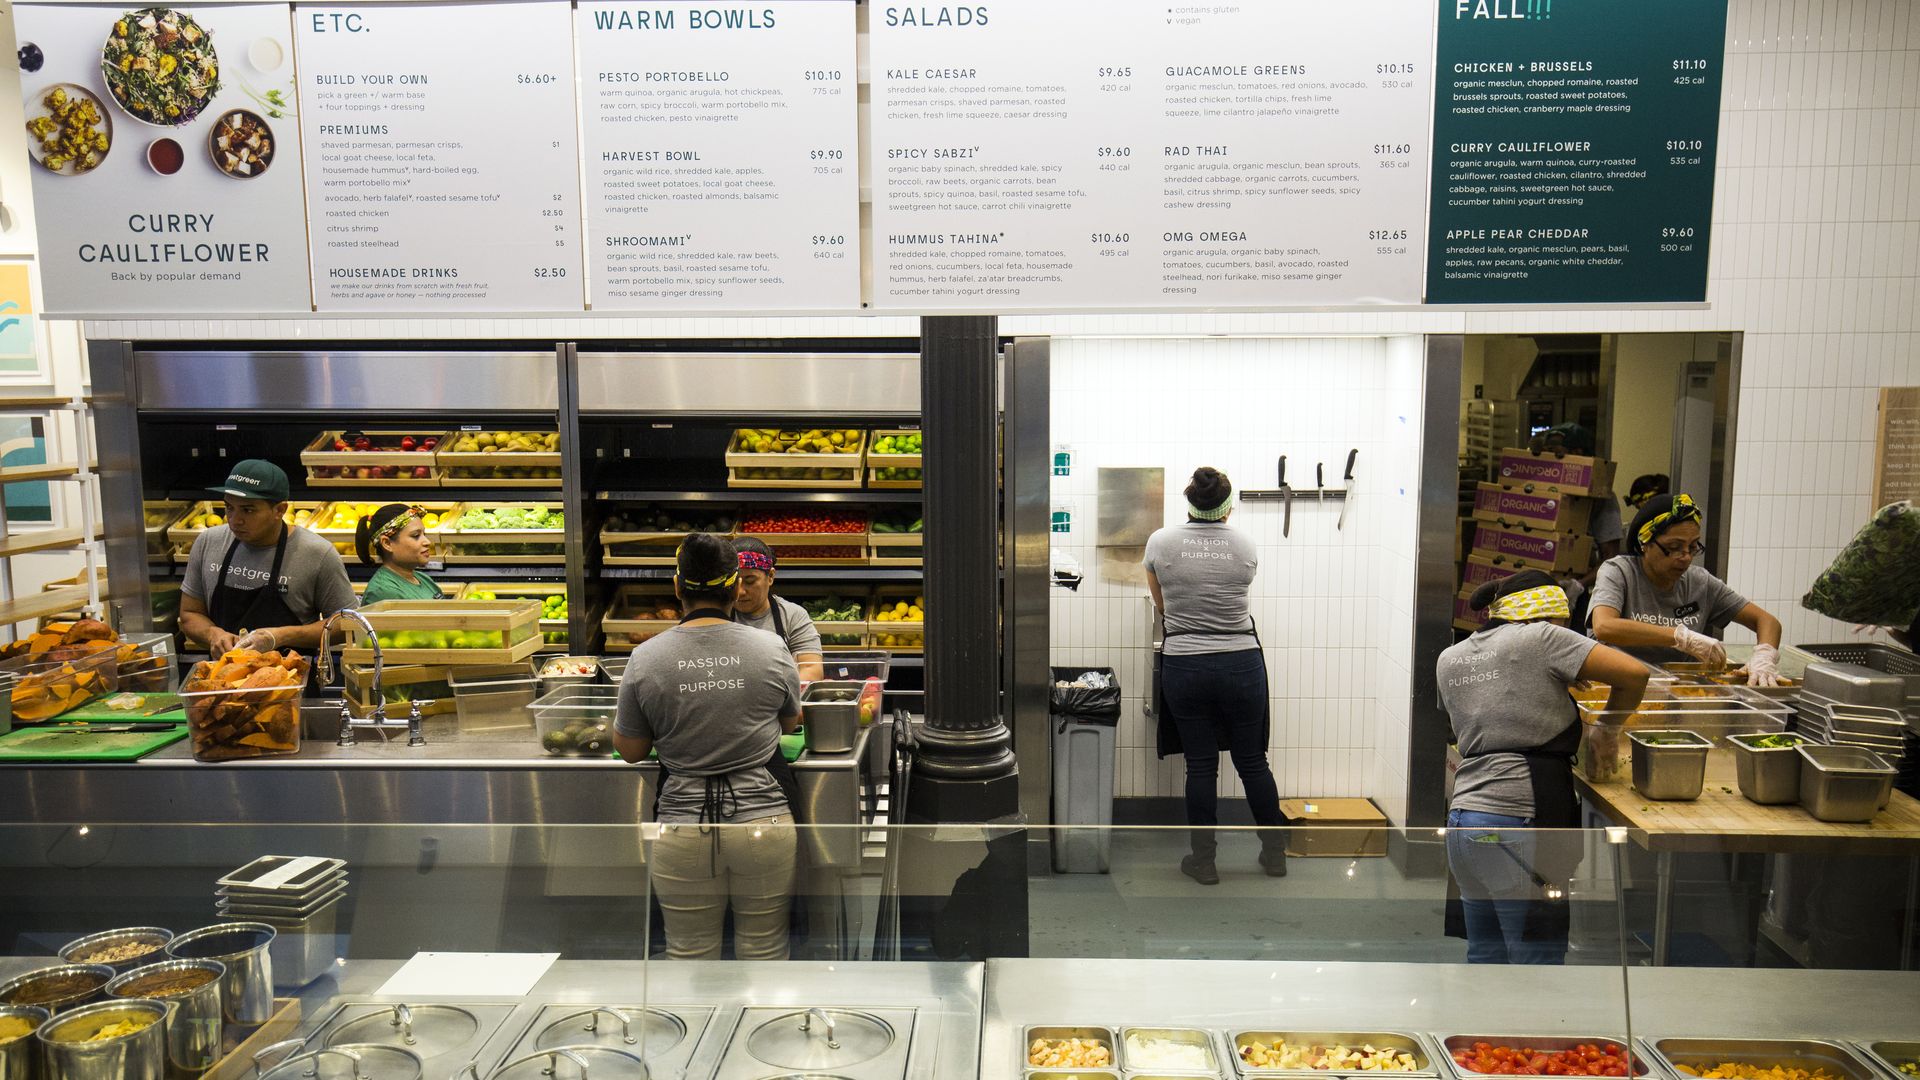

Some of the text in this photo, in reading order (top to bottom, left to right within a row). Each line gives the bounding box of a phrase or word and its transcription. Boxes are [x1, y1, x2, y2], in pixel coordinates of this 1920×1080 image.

[1175, 5, 1241, 15] contains gluten
[1456, 0, 1551, 23] FALL!!!
[595, 10, 776, 31] WARM BOWLS
[886, 7, 989, 27] SALADS
[1175, 17, 1201, 26] vegan
[313, 14, 371, 33] ETC.
[1165, 64, 1306, 77] GUACAMOLE GREENS
[1376, 63, 1414, 75] $10.15
[1453, 61, 1593, 73] CHICKEN + BRUSSELS
[1672, 59, 1707, 71] $11.10
[599, 71, 729, 83] PESTO PORTOBELLO
[804, 70, 841, 81] $10.10
[887, 68, 977, 79] KALE CAESAR
[1098, 67, 1132, 78] $9.65
[315, 73, 429, 85] BUILD YOUR OWN
[517, 73, 557, 85] $6.60+
[1381, 79, 1413, 89] 530 cal
[1673, 75, 1705, 85] 425 cal
[812, 87, 842, 96] 775 cal
[1099, 83, 1131, 93] 420 cal
[1452, 105, 1485, 114] roasted
[1523, 104, 1565, 114] cranberry
[1566, 103, 1593, 113] maple
[1594, 103, 1631, 113] dressing
[319, 124, 389, 135] PREMIUMS
[551, 141, 560, 149] $1
[1373, 143, 1411, 155] $11.60
[1450, 141, 1591, 153] CURRY CAULIFLOWER
[1666, 139, 1703, 151] $10.10
[602, 151, 701, 161] HARVEST BOWL
[810, 149, 843, 161] $9.90
[887, 148, 928, 159] SPICY
[1097, 146, 1131, 157] $9.60
[1164, 145, 1227, 157] RAD THAI
[1379, 160, 1410, 169] 365 cal
[1669, 156, 1701, 165] 535 cal
[813, 166, 843, 175] 705 cal
[1099, 163, 1131, 172] 440 cal
[552, 193, 562, 201] $2
[1448, 196, 1584, 207] cucumber tahini yogurt dressing
[604, 205, 649, 215] vinaigrette
[1163, 200, 1232, 210] cashew dressing
[325, 209, 390, 217] roasted chicken
[542, 209, 564, 217] $2.50
[129, 214, 215, 233] CURRY
[326, 225, 379, 233] citrus shrimp
[554, 224, 564, 232] $4
[1091, 232, 1130, 243] $10.60
[1163, 231, 1247, 242] OMG OMEGA
[1368, 229, 1407, 241] $12.65
[1446, 228, 1589, 240] APPLE PEAR CHEDDAR
[1661, 227, 1694, 238] $9.60
[327, 239, 400, 248] roasted steelhead
[555, 239, 565, 247] $5
[812, 235, 845, 246] $9.60
[889, 234, 945, 245] HUMMUS
[1099, 249, 1130, 257] 495 cal
[1376, 246, 1407, 255] 555 cal
[1660, 243, 1693, 252] 500 cal
[79, 244, 269, 263] CAULIFLOWER
[813, 251, 845, 259] 640 cal
[1476, 259, 1493, 267] raw
[1528, 257, 1560, 267] organic
[1561, 257, 1586, 266] white
[111, 271, 241, 283] Back by popular demand
[329, 267, 458, 278] HOUSEMADE DRINKS
[534, 267, 567, 278] $2.50
[1444, 270, 1529, 280] balsamic vinaigrette
[927, 275, 947, 283] herb
[977, 275, 1005, 283] za'atar
[607, 289, 628, 297] miso
[661, 289, 688, 298] ginger
[688, 288, 724, 298] dressing
[889, 287, 1021, 297] cucumber tahini yogurt dressing
[1511, 463, 1560, 478] ORGANIC
[1501, 498, 1547, 513] ORGANIC
[1183, 538, 1229, 546] PASSION
[1500, 538, 1546, 554] ORGANIC
[1181, 552, 1233, 560] PURPOSE
[1631, 611, 1700, 627] weetgreen
[1449, 649, 1498, 666] PASSION
[678, 656, 740, 671] PASSION
[1448, 669, 1500, 688] PURPOSE
[679, 679, 745, 694] PURPOSE
